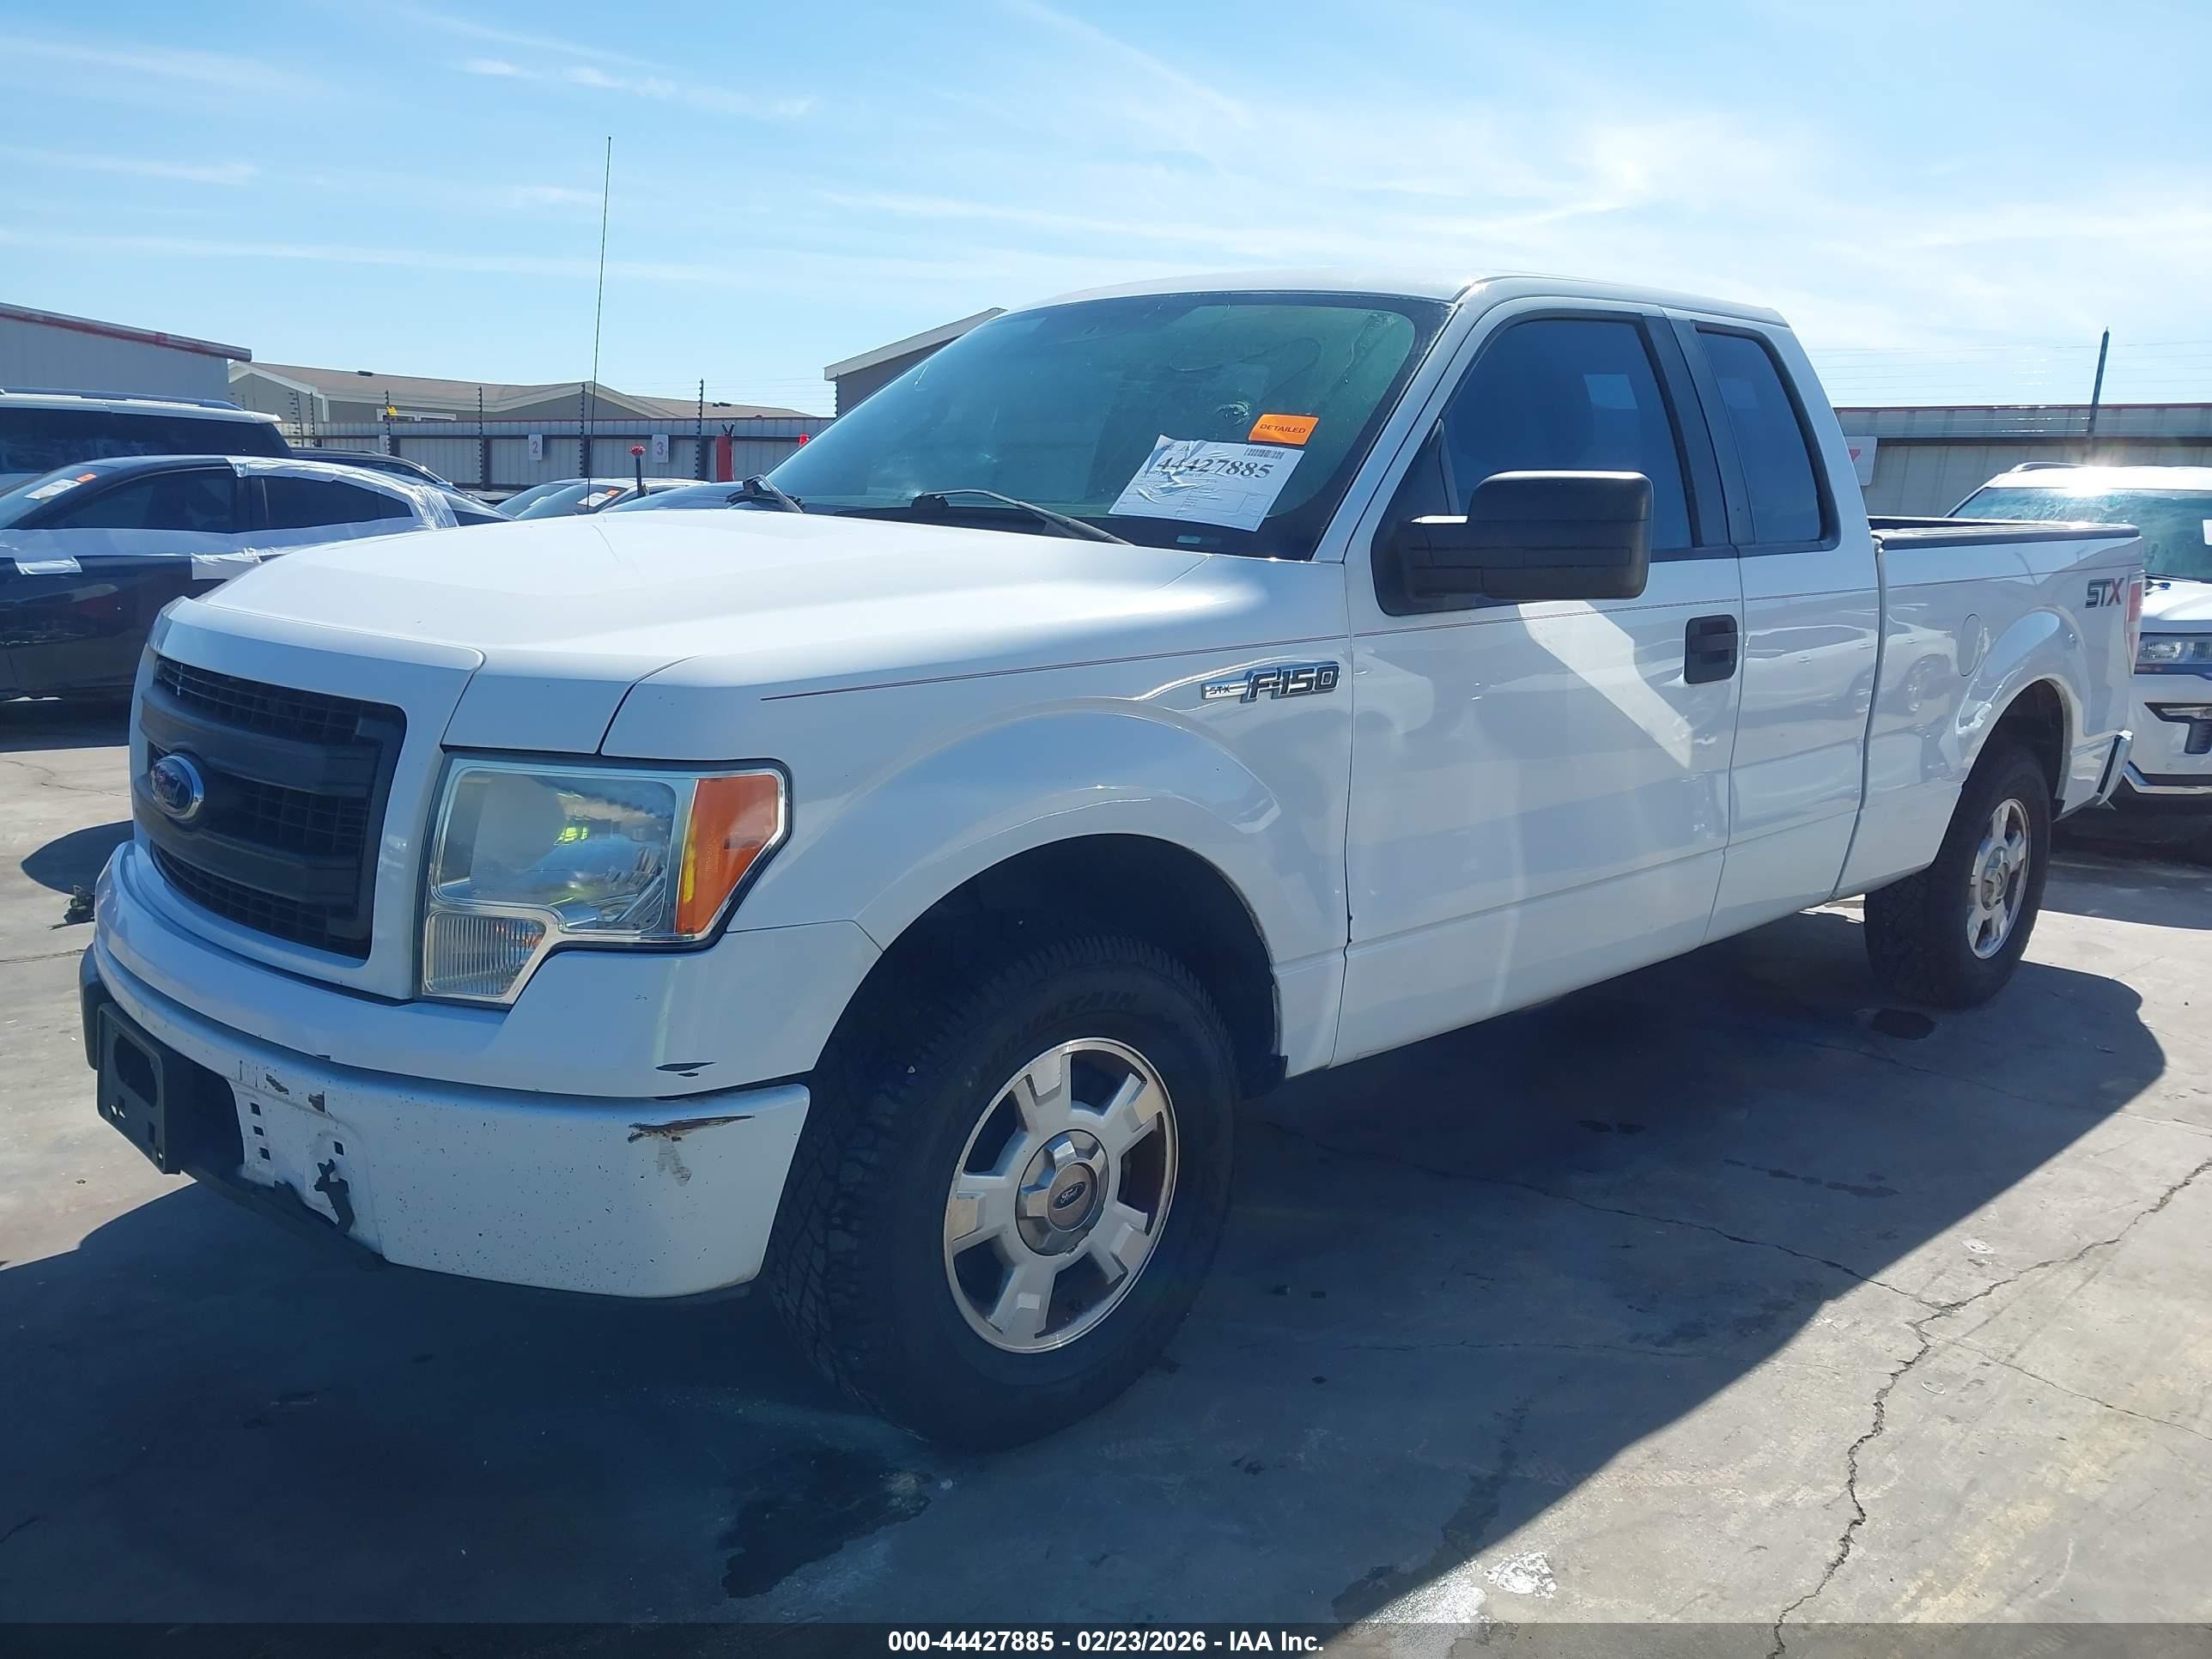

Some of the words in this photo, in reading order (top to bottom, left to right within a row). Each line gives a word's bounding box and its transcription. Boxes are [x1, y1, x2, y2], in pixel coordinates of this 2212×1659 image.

[1259, 423, 1307, 434] DETAILED
[532, 440, 538, 454] 2
[656, 441, 664, 456] 3
[1157, 456, 1275, 479] 44427885
[2085, 577, 2125, 609] STX
[1244, 662, 1340, 702] F-150
